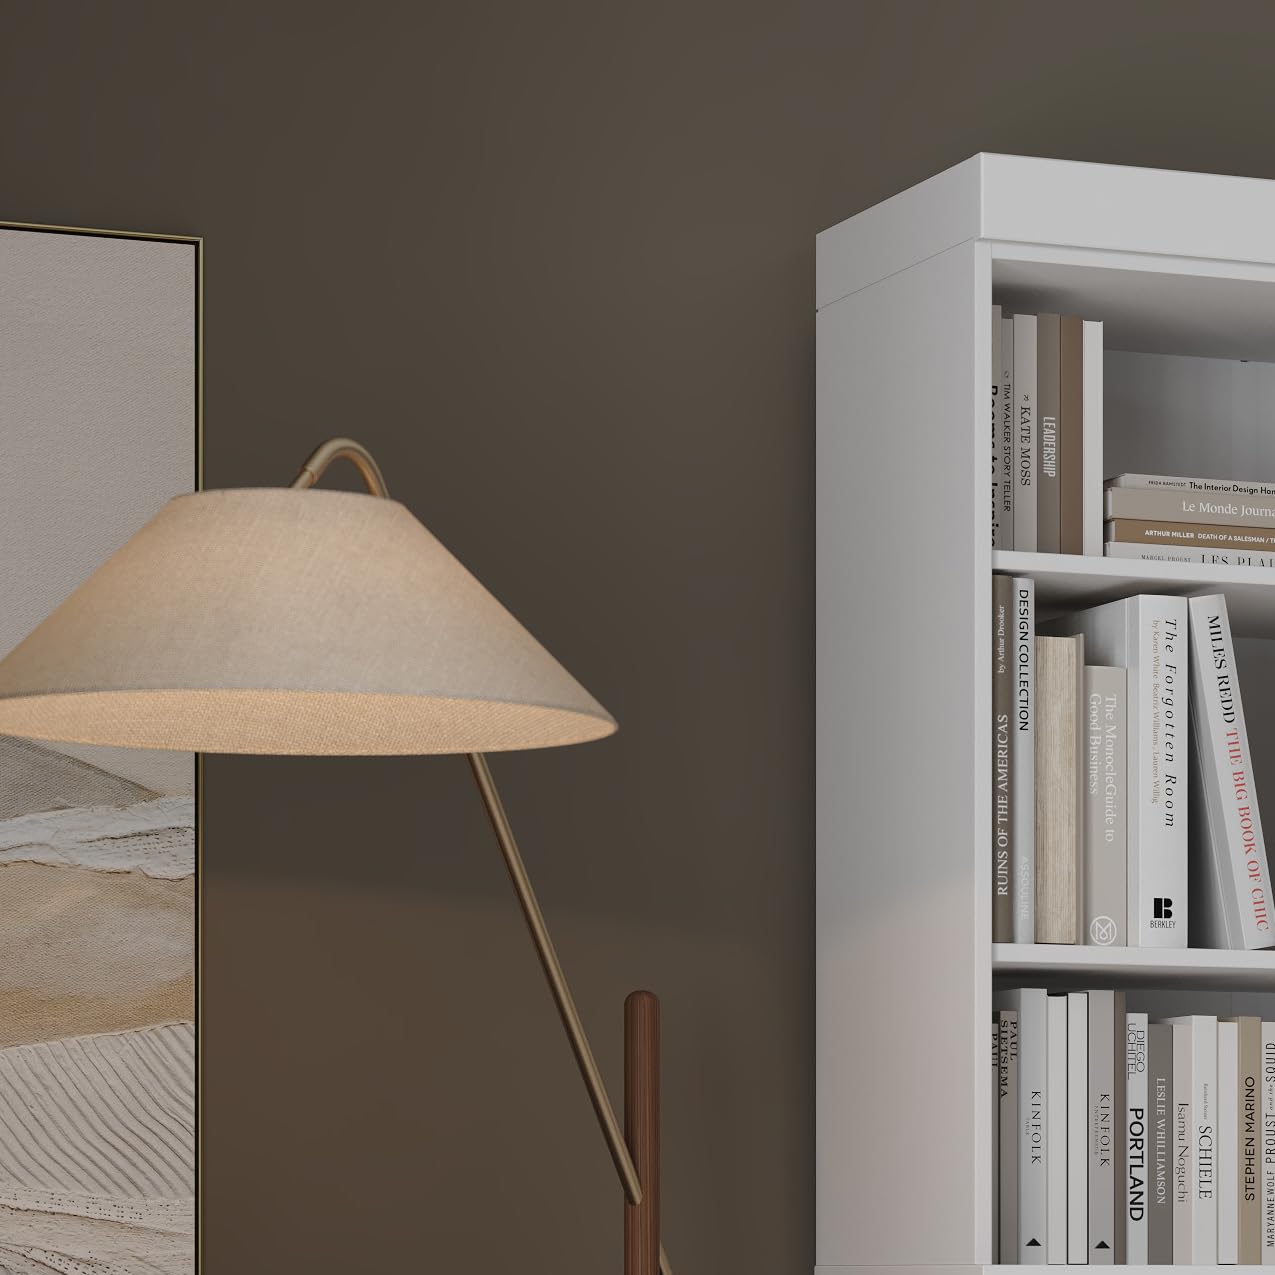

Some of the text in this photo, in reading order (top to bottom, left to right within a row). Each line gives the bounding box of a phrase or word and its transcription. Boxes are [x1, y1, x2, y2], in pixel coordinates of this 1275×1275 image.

[1021, 406, 1030, 486] KATE MOSS
[1043, 417, 1055, 477] LEADERSHIP
[1189, 482, 1202, 490] The
[1204, 483, 1231, 492] Interior
[1233, 485, 1258, 495] Design
[1182, 501, 1196, 512] Le
[1199, 503, 1237, 515] Monde
[1018, 589, 1029, 731] DESIGN COLLECTION
[1163, 619, 1176, 827] The Forgotten Room
[997, 714, 1008, 896] RUINS OF THE AMERICAS
[1207, 615, 1269, 932] MILES REDD THE BIG BOOK OF CHIC
[1031, 1091, 1041, 1164] KINFOLK
[1100, 1094, 1110, 1167] KINFOLK
[1156, 1078, 1165, 1116] LESLIE
[1245, 1076, 1255, 1201] STEPHEN MARINO
[1265, 1043, 1275, 1164] PROUST SQUID
[1129, 1108, 1144, 1221] PORTLAND
[1175, 1103, 1189, 1203] Isamu Noguchi
[1198, 1125, 1212, 1199] SCHIELE
